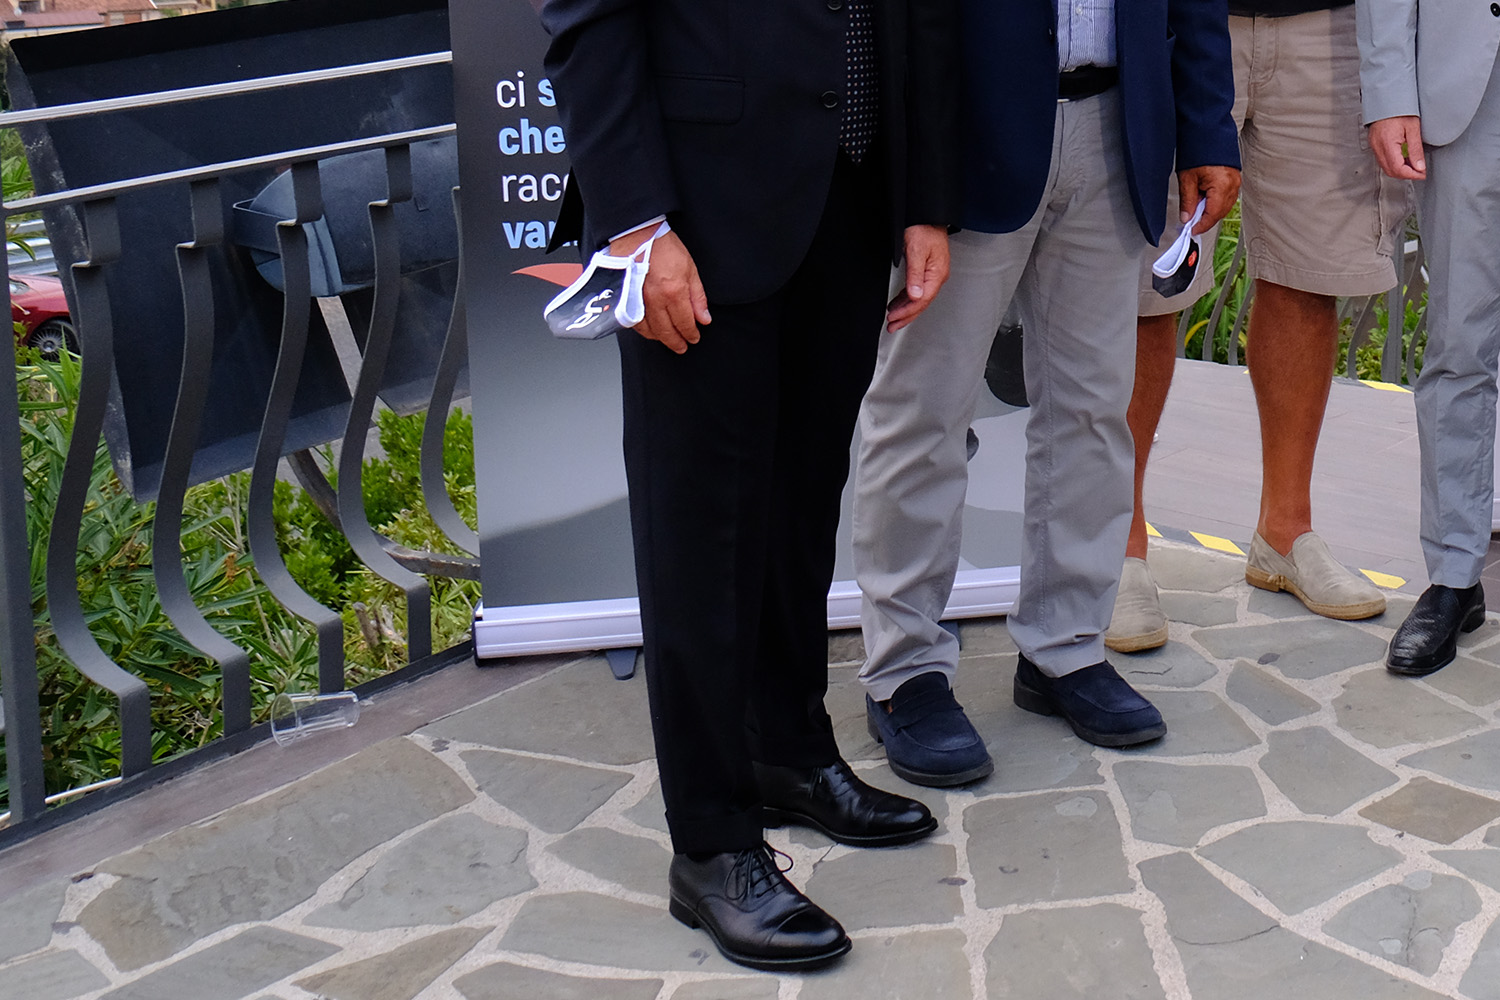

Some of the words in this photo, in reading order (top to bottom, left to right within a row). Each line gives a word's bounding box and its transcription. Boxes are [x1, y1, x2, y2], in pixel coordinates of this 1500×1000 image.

[496, 70, 526, 109] ci
[499, 118, 567, 155] che
[502, 173, 570, 202] rac
